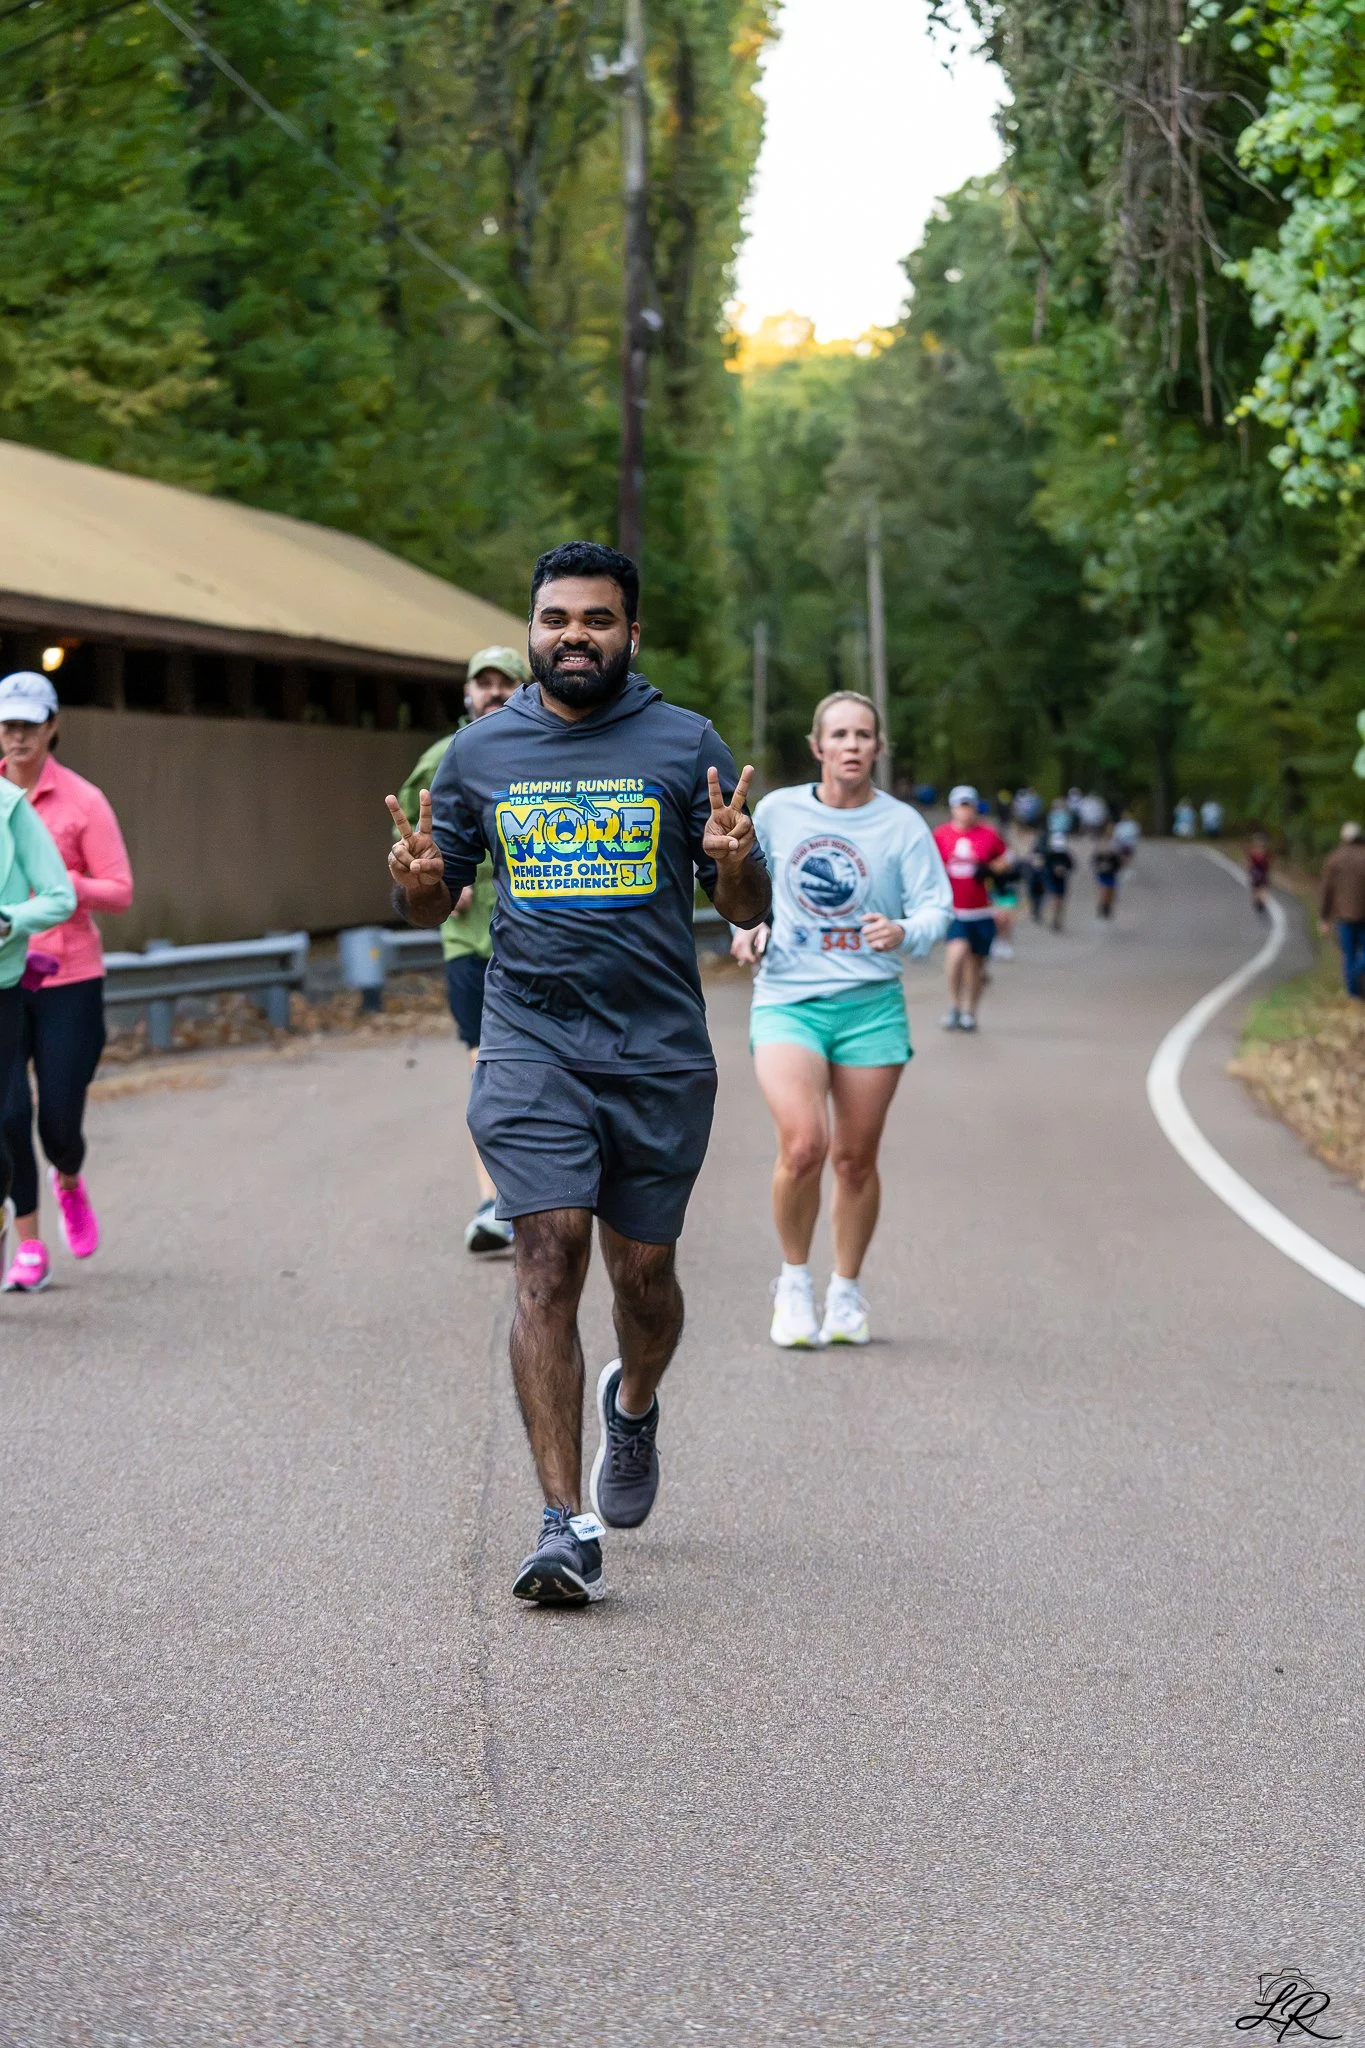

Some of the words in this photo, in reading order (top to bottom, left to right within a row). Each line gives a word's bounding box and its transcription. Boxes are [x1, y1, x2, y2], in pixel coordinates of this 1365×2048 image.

[509, 780, 572, 795] MEMPHIS
[576, 778, 645, 793] RUNNERS
[509, 795, 544, 806] TRACK
[616, 793, 644, 803] CLUB
[500, 806, 655, 861] MORE
[511, 863, 573, 878] MEMBERS
[577, 862, 619, 876] ONLY
[620, 862, 653, 887] 5K
[514, 879, 536, 891] RACE
[537, 877, 619, 890] EXPERIENCE
[821, 932, 861, 951] 543
